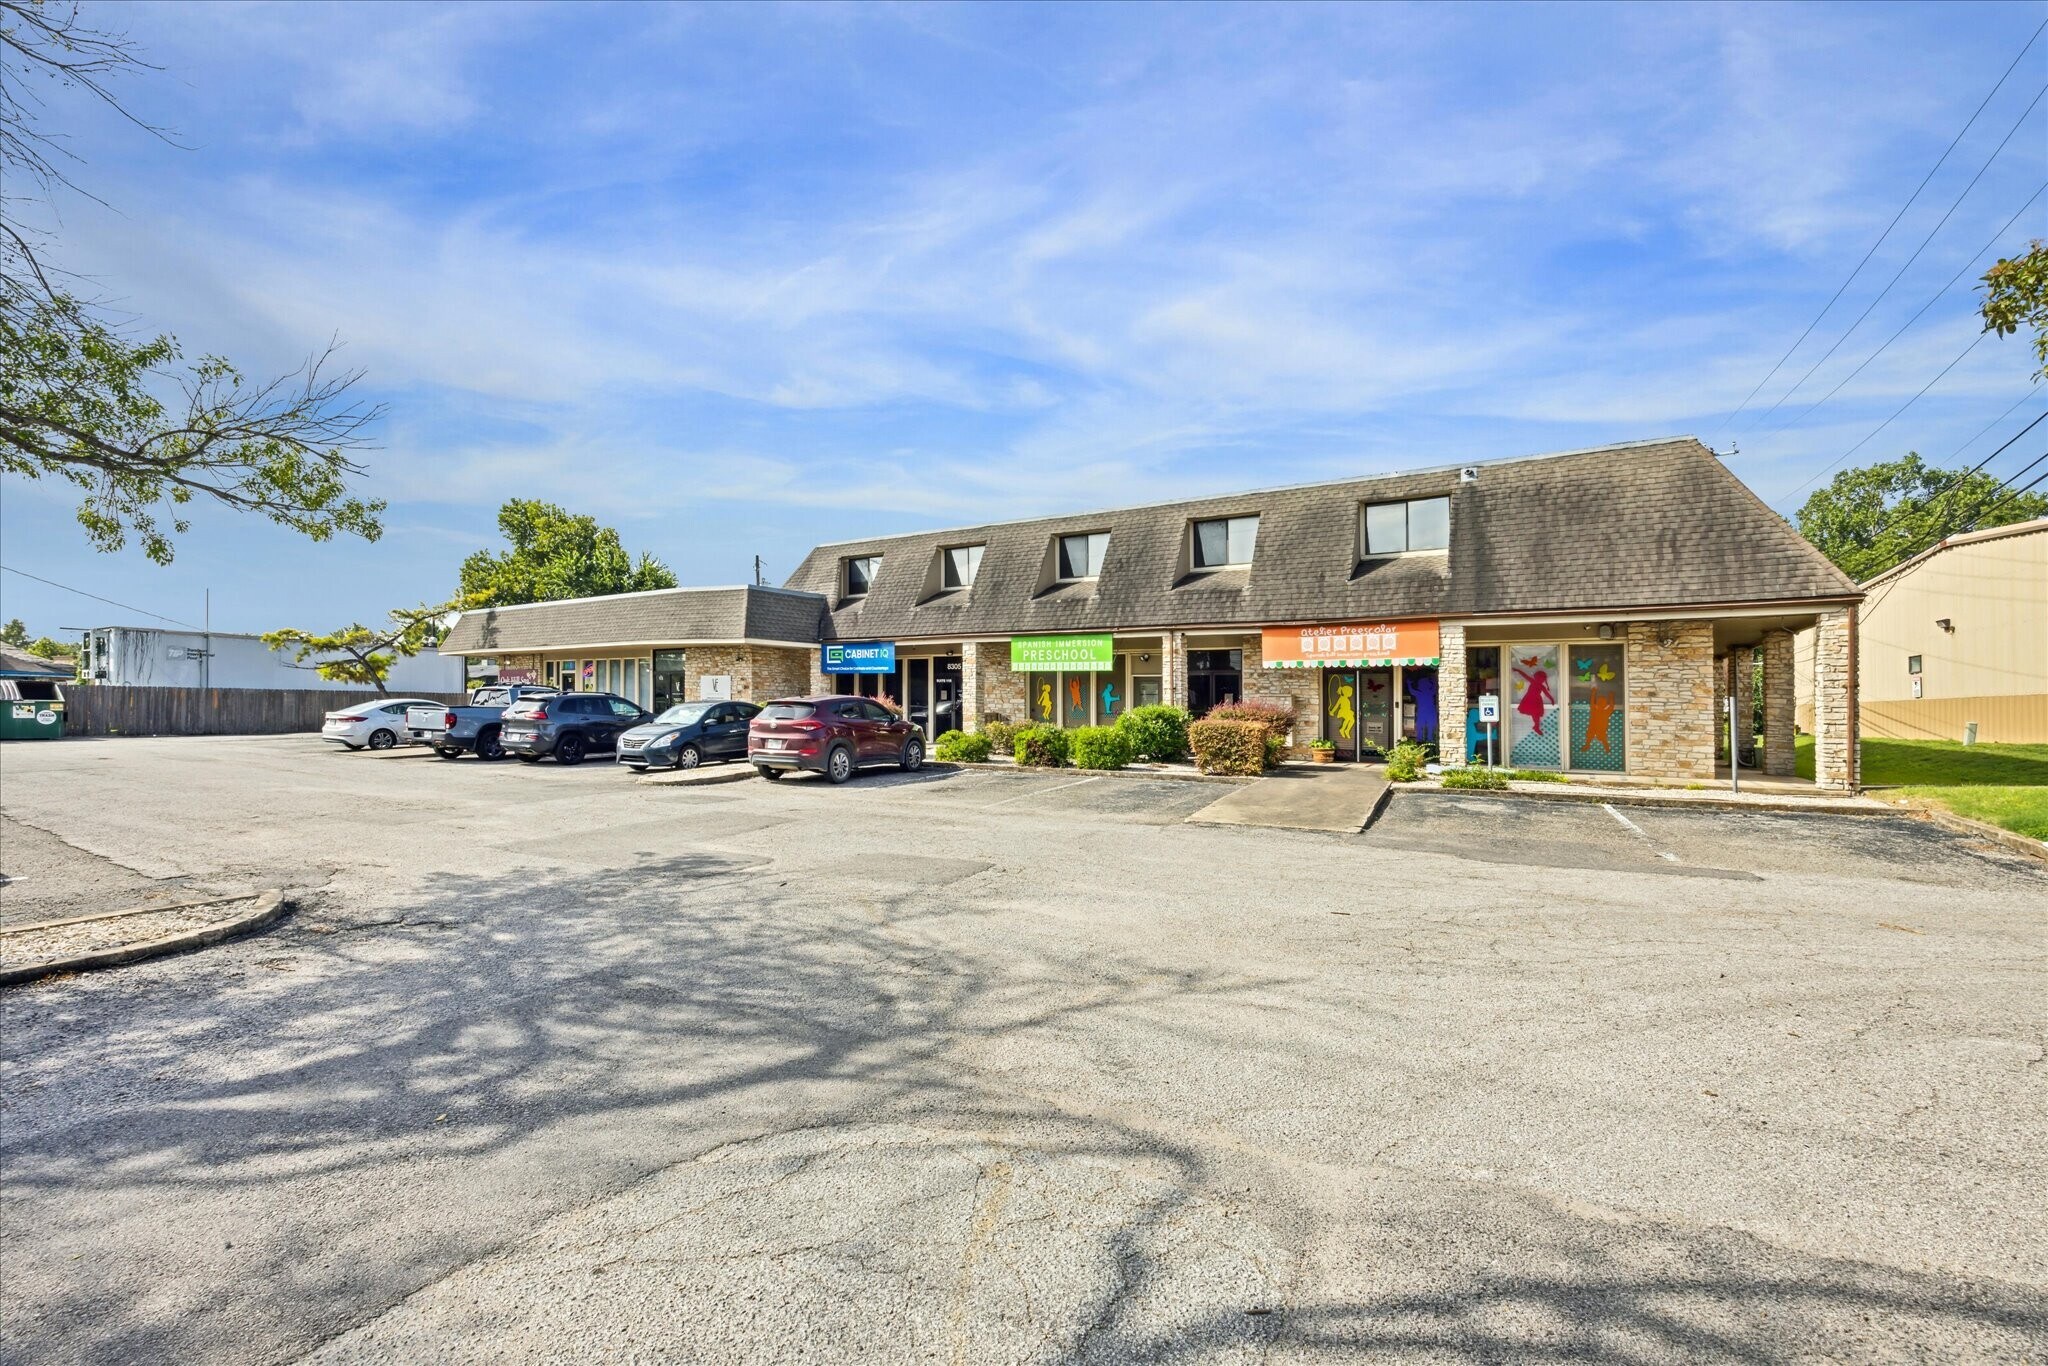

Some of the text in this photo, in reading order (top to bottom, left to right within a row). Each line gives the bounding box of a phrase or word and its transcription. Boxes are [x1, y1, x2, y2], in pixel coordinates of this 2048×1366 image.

[1055, 639, 1103, 647] IMMERSION
[168, 649, 184, 657] TIP
[845, 648, 889, 659] CABINET IQ
[1023, 649, 1097, 661] PRESCHOOL
